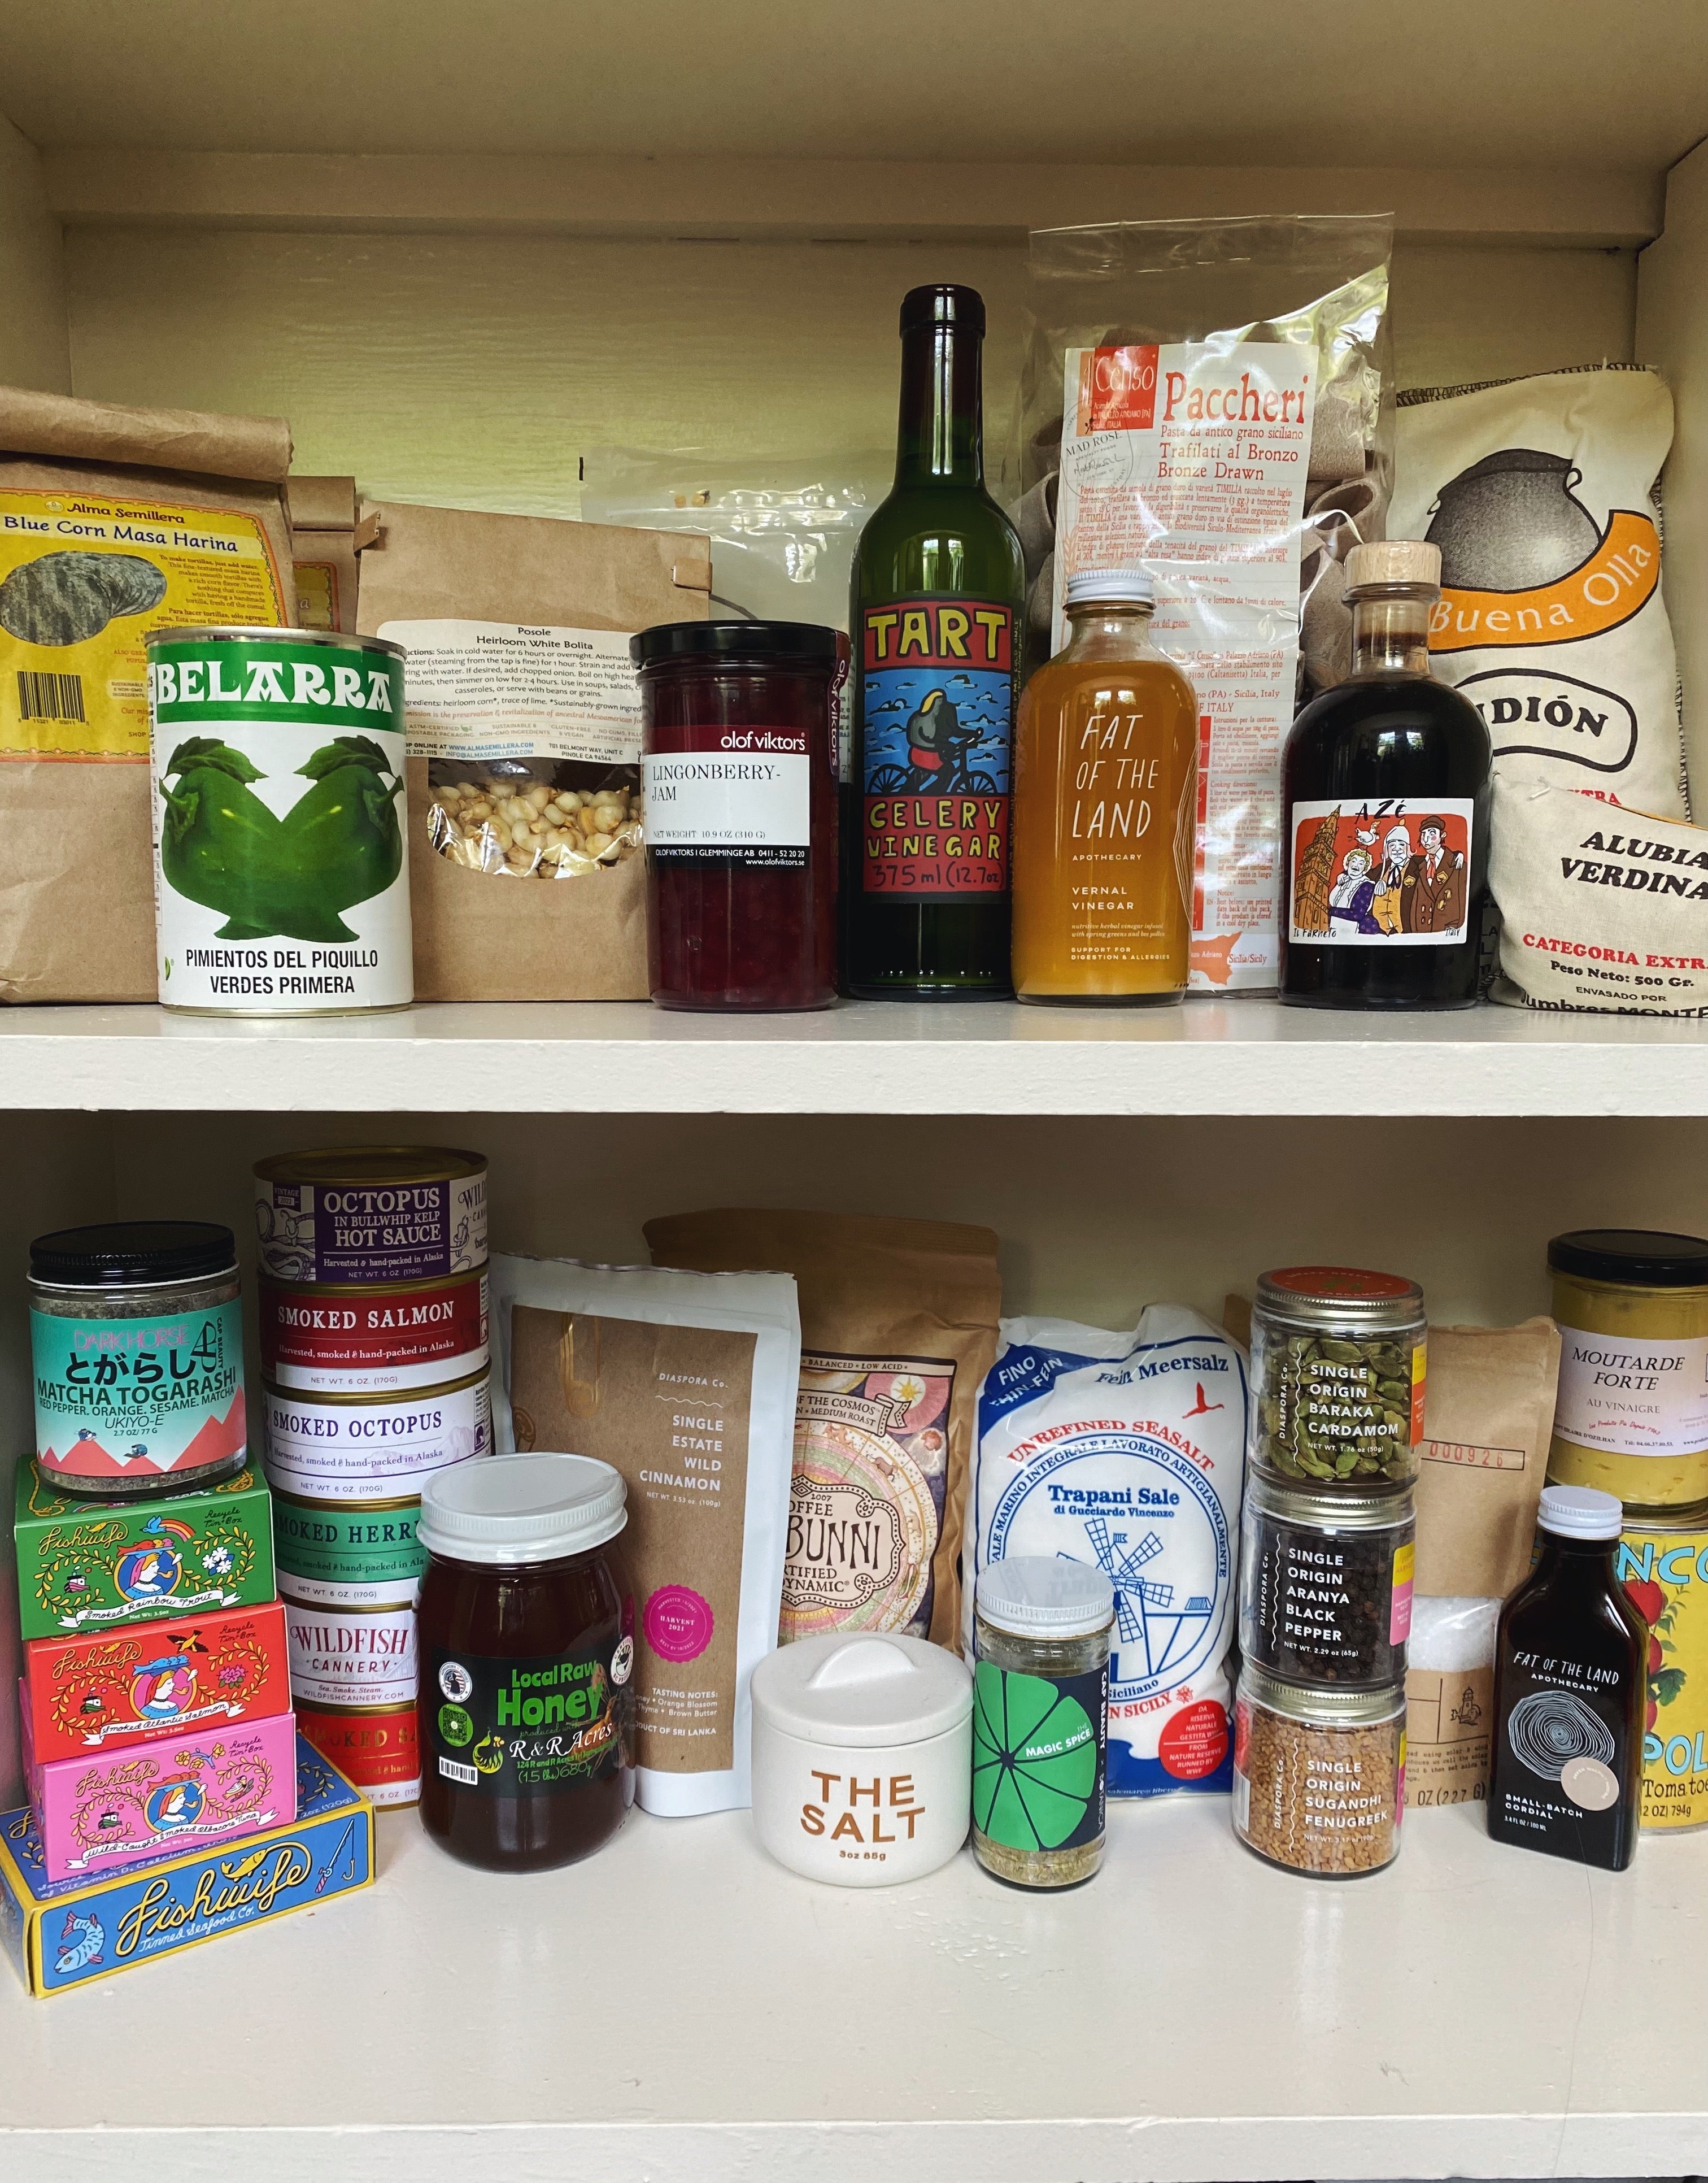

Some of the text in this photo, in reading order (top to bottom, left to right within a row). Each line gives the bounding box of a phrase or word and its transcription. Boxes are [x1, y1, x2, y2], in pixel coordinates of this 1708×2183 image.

[1163, 371, 1309, 424] Paccheri
[1161, 425, 1302, 441] Pasta da antico grano siciliano
[1160, 442, 1299, 462] Trafilati al Bronzo
[1158, 462, 1264, 481] Bronze Drawn
[67, 503, 185, 524] Alma Semillera
[4, 516, 238, 553] Blue Corn Masa Harina
[1429, 543, 1651, 633] Buena Olla
[518, 627, 551, 636] Posole
[868, 609, 1005, 659] TART
[477, 636, 593, 650] Heirloom White Bolita
[156, 659, 394, 713] BELARRA
[455, 686, 495, 695] casseroles,
[721, 731, 805, 751] olof viktors
[1080, 715, 1143, 750] FAT
[448, 742, 534, 750] WWW.ALMASEMILLERA.COM
[653, 764, 781, 781] LINGONBERRY-
[1076, 759, 1159, 790] OF THE
[652, 786, 677, 801] JAM
[869, 799, 1002, 828] CELERY
[1072, 799, 1151, 838] LAND
[867, 835, 1001, 859] VINEGAR
[1072, 902, 1134, 910] VINEGAR
[186, 949, 378, 968] PIMIENTOS DEL PIQUILLO
[1523, 934, 1640, 966] CATEGORIA
[1550, 960, 1694, 987] Peso Neto: 500 Gr.
[211, 976, 355, 994] VERDES PRIMERA
[324, 1188, 440, 1214] OCTOPUS
[335, 1211, 440, 1227] IN BULLWHIP KELP
[335, 1224, 441, 1247] HOT SAUCE
[278, 1301, 454, 1329] SMOKED SALMON
[66, 1349, 195, 1385] とがらし
[1139, 1355, 1228, 1380] Meersalz
[1572, 1347, 1685, 1371] MOUTARDE
[999, 1356, 1035, 1385] FINO
[1310, 1365, 1367, 1379] SINGLE
[38, 1366, 236, 1405] MATCHA TOGARASHI
[1310, 1384, 1367, 1398] ORIGIN
[1593, 1372, 1659, 1390] FORTE
[40, 1388, 234, 1416] RED PEPPER. ORANGE. SESAME. MATCHA
[808, 1395, 875, 1415] THE COSMOS
[1310, 1402, 1374, 1417] BARAKA
[1587, 1398, 1660, 1414] AU VINAIGRE
[105, 1415, 164, 1429] UKIYO-E
[273, 1410, 442, 1437] SMOKED OCTOPUS
[673, 1415, 724, 1431] SINGLE
[811, 1407, 875, 1426] MEDIUM ROAST
[1308, 1423, 1398, 1436] CARDAMOM
[672, 1436, 722, 1451] ESTATE
[1006, 1420, 1215, 1471] UNREFINED SEASALT
[685, 1457, 721, 1471] WILD
[1428, 1442, 1504, 1467] 000926
[639, 1470, 720, 1491] CINNAMON
[1048, 1485, 1179, 1506] Trapani Sale
[1054, 1506, 1174, 1518] di Gucciardo Vincenzo
[38, 1521, 129, 1555] Fishwife
[1289, 1548, 1344, 1566] SINGLE
[1288, 1567, 1343, 1585] ORIGIN
[1287, 1586, 1350, 1604] ARANYA
[85, 1593, 212, 1619] Smoked Rainbow Trout
[1286, 1603, 1335, 1622] BLACK
[290, 1625, 408, 1654] WILDFISH
[1286, 1622, 1342, 1641] PEPPER
[52, 1641, 142, 1679] Fishwife
[312, 1658, 390, 1673] CANNERY
[1514, 1651, 1619, 1686] FAT OF THE LAND
[512, 1660, 597, 1688] Local Raw
[1531, 1673, 1599, 1693] APOTHECARY
[304, 1689, 403, 1702] WILDFISHCANNERY.COM
[498, 1682, 603, 1726] Honey
[1026, 1728, 1091, 1757] MAGIC SPICE
[1170, 1748, 1221, 1760] NATURE RESERVE
[1308, 1760, 1361, 1773] SINGLE
[75, 1759, 160, 1796] Fishwife
[1306, 1778, 1361, 1791] ORIGIN
[812, 1770, 914, 1807] THE
[1305, 1794, 1382, 1810] SUGANDHI
[1505, 1794, 1583, 1819] SMALL-BATCH
[1505, 1802, 1553, 1820] CORDIAL
[800, 1804, 925, 1843] SALT
[1305, 1810, 1388, 1828] FENUGREEK
[115, 1842, 313, 1958] Fishwife
[138, 1906, 255, 1953] Tinned Seafood Co.
